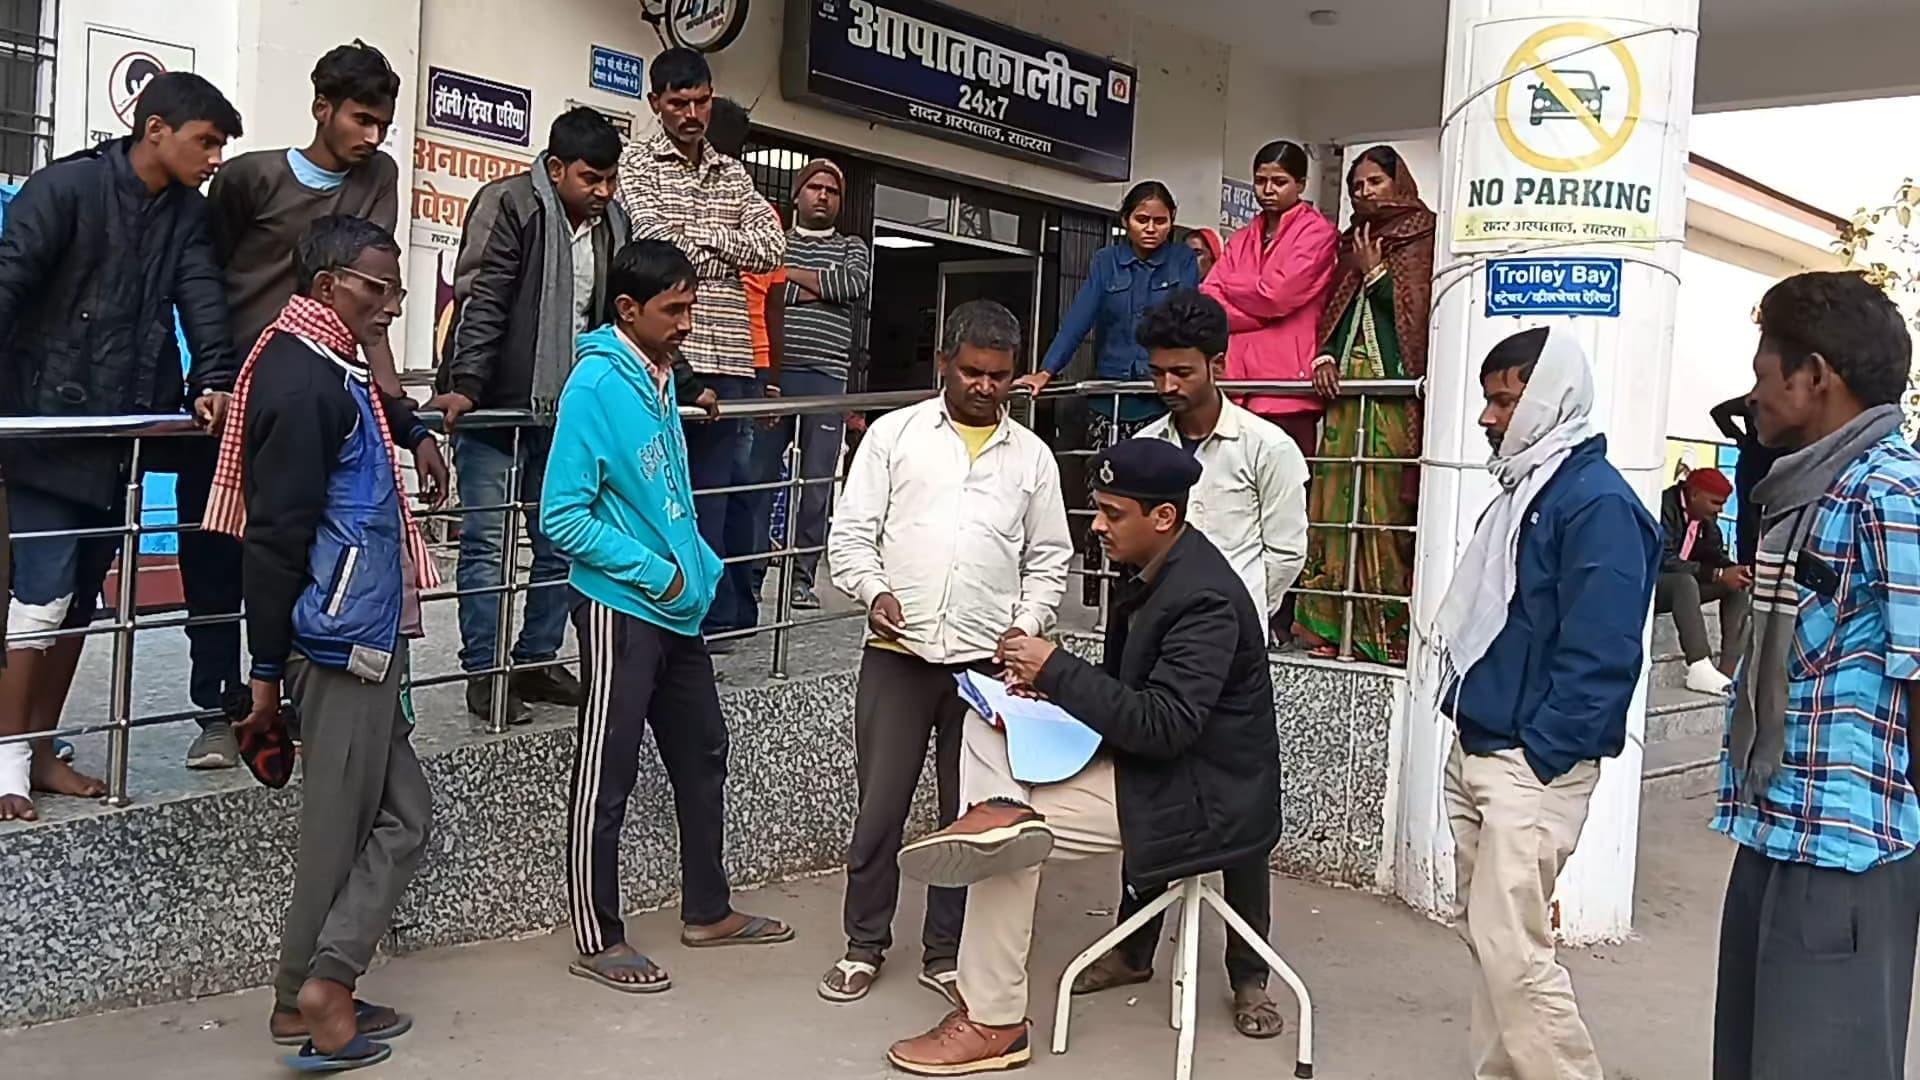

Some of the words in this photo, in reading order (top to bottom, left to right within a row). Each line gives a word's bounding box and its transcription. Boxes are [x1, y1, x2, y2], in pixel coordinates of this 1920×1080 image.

[848, 0, 1101, 118] आपातकालीन
[908, 103, 943, 123] सदर
[958, 84, 1009, 121] 24x7
[1467, 178, 1505, 208] NO
[1513, 177, 1652, 214] PARKING
[1482, 220, 1511, 233] सदर
[1496, 265, 1567, 288] Trolley
[1571, 265, 1612, 288] Bay
